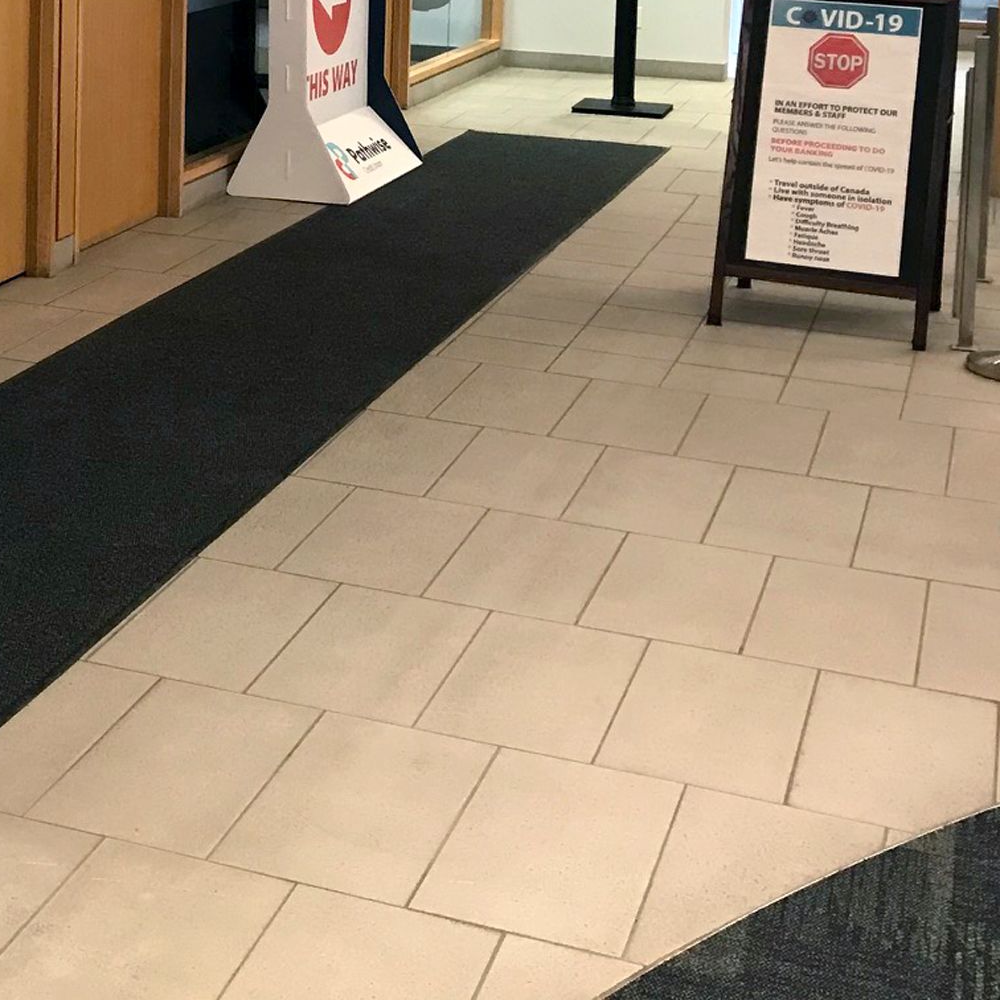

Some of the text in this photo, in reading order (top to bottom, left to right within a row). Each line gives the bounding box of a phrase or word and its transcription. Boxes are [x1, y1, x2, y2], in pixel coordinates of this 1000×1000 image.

[814, 52, 863, 73] STOP
[332, 58, 359, 93] WAY
[774, 106, 813, 116] MEMBERS
[822, 110, 846, 119] STAFF
[785, 100, 797, 108] AN
[798, 101, 829, 110] EFFORT
[830, 103, 841, 112] TO
[842, 105, 879, 115] PROTECT
[880, 108, 898, 117] OUR
[837, 124, 877, 134] FOLLOWING
[345, 136, 392, 165] Pathwise
[770, 137, 886, 155] BEFORE PROCEEDING TO DO
[770, 145, 833, 158] YOUR BANKING
[774, 179, 798, 188] Travel
[799, 183, 828, 191] outside
[840, 186, 870, 195] Canada
[773, 194, 793, 202] Have
[794, 197, 835, 207] symptoms
[846, 202, 887, 212] COVID-19
[810, 191, 846, 200] someone
[857, 195, 893, 206] isolation
